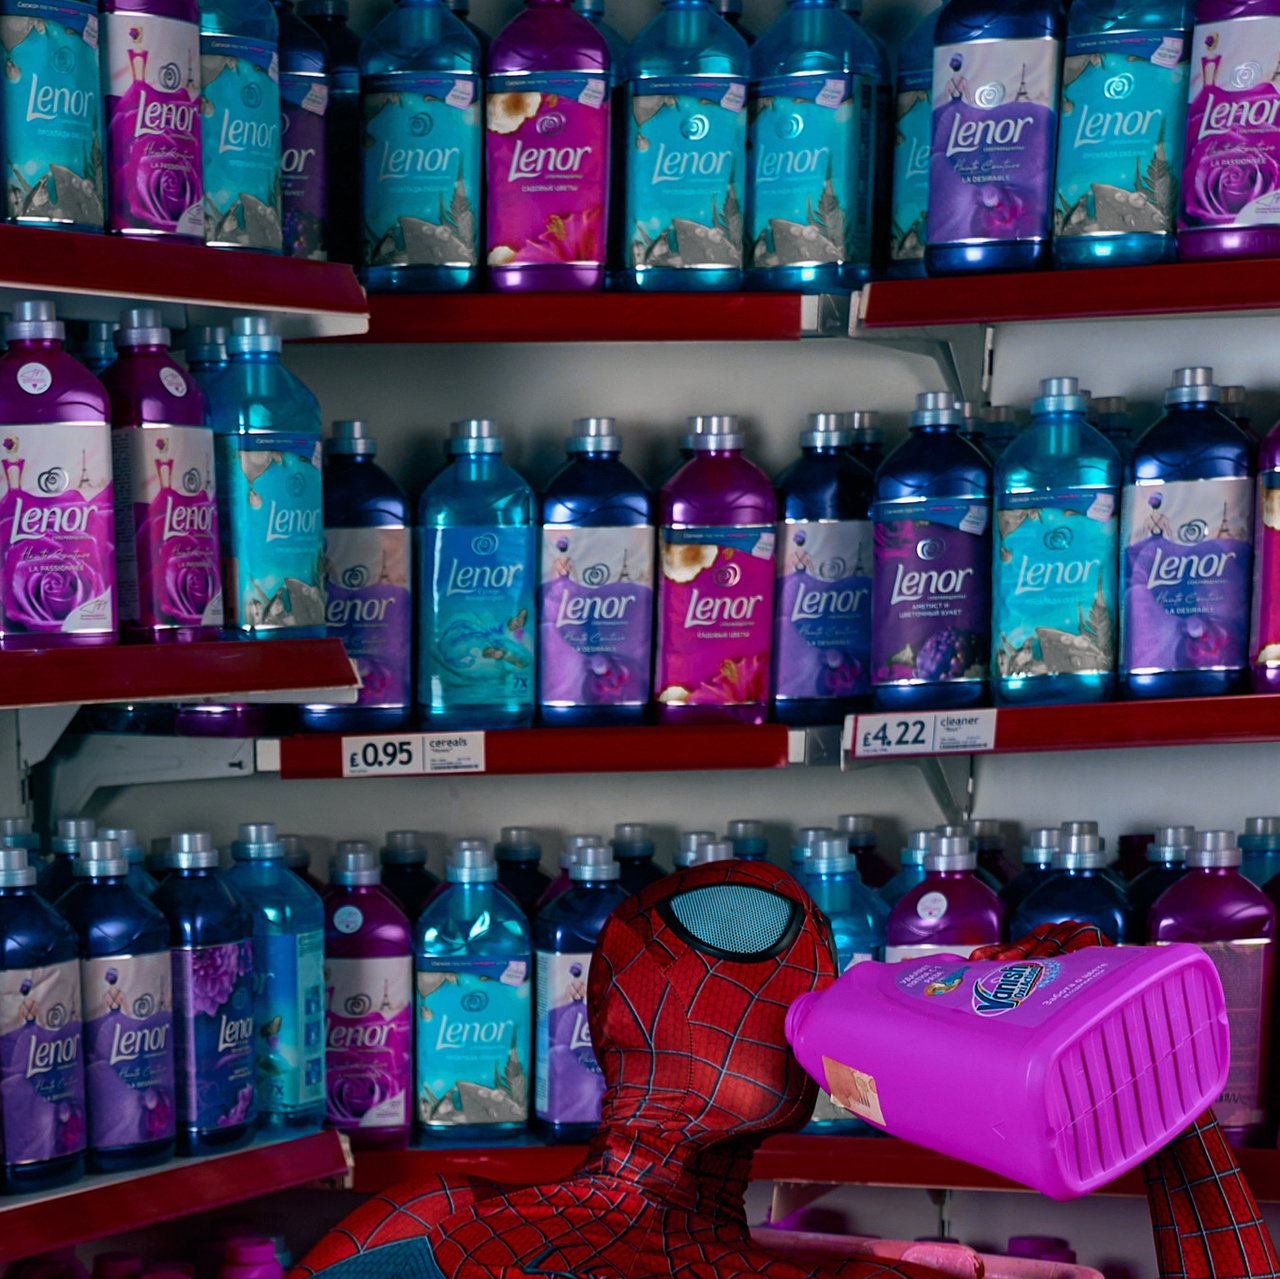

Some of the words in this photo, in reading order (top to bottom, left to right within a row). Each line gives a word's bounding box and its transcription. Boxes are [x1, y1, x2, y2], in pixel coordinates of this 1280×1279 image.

[26, 74, 93, 121] Lenor
[135, 90, 199, 137] Lenor
[1198, 94, 1280, 140] Lenor
[219, 109, 276, 153] Lenor
[946, 113, 1033, 157] Lenor
[1074, 105, 1162, 148] Lenor
[380, 142, 460, 180] Lenor
[508, 140, 591, 182] Lenor
[652, 143, 732, 184] Lenor
[756, 145, 828, 183] Lenor
[9, 498, 98, 544] Lenor
[163, 496, 214, 540] Lenor
[266, 501, 320, 542] Lenor
[27, 564, 38, 573] LA
[447, 558, 523, 596] Lenor
[890, 564, 973, 605] Lenor
[1015, 555, 1099, 594] Lenor
[1147, 548, 1236, 589] Lenor
[556, 589, 636, 628] Lenor
[684, 589, 763, 628] Lenor
[791, 583, 868, 622] Lenor
[429, 737, 467, 748] cereals
[863, 720, 925, 747] £4.22
[940, 717, 979, 727] cleaner
[350, 741, 412, 768] £0.95
[975, 962, 1030, 1013] Vanish
[109, 1022, 169, 1065] Lenor
[436, 1015, 513, 1050] Lenor
[26, 1034, 80, 1079] Lenor
